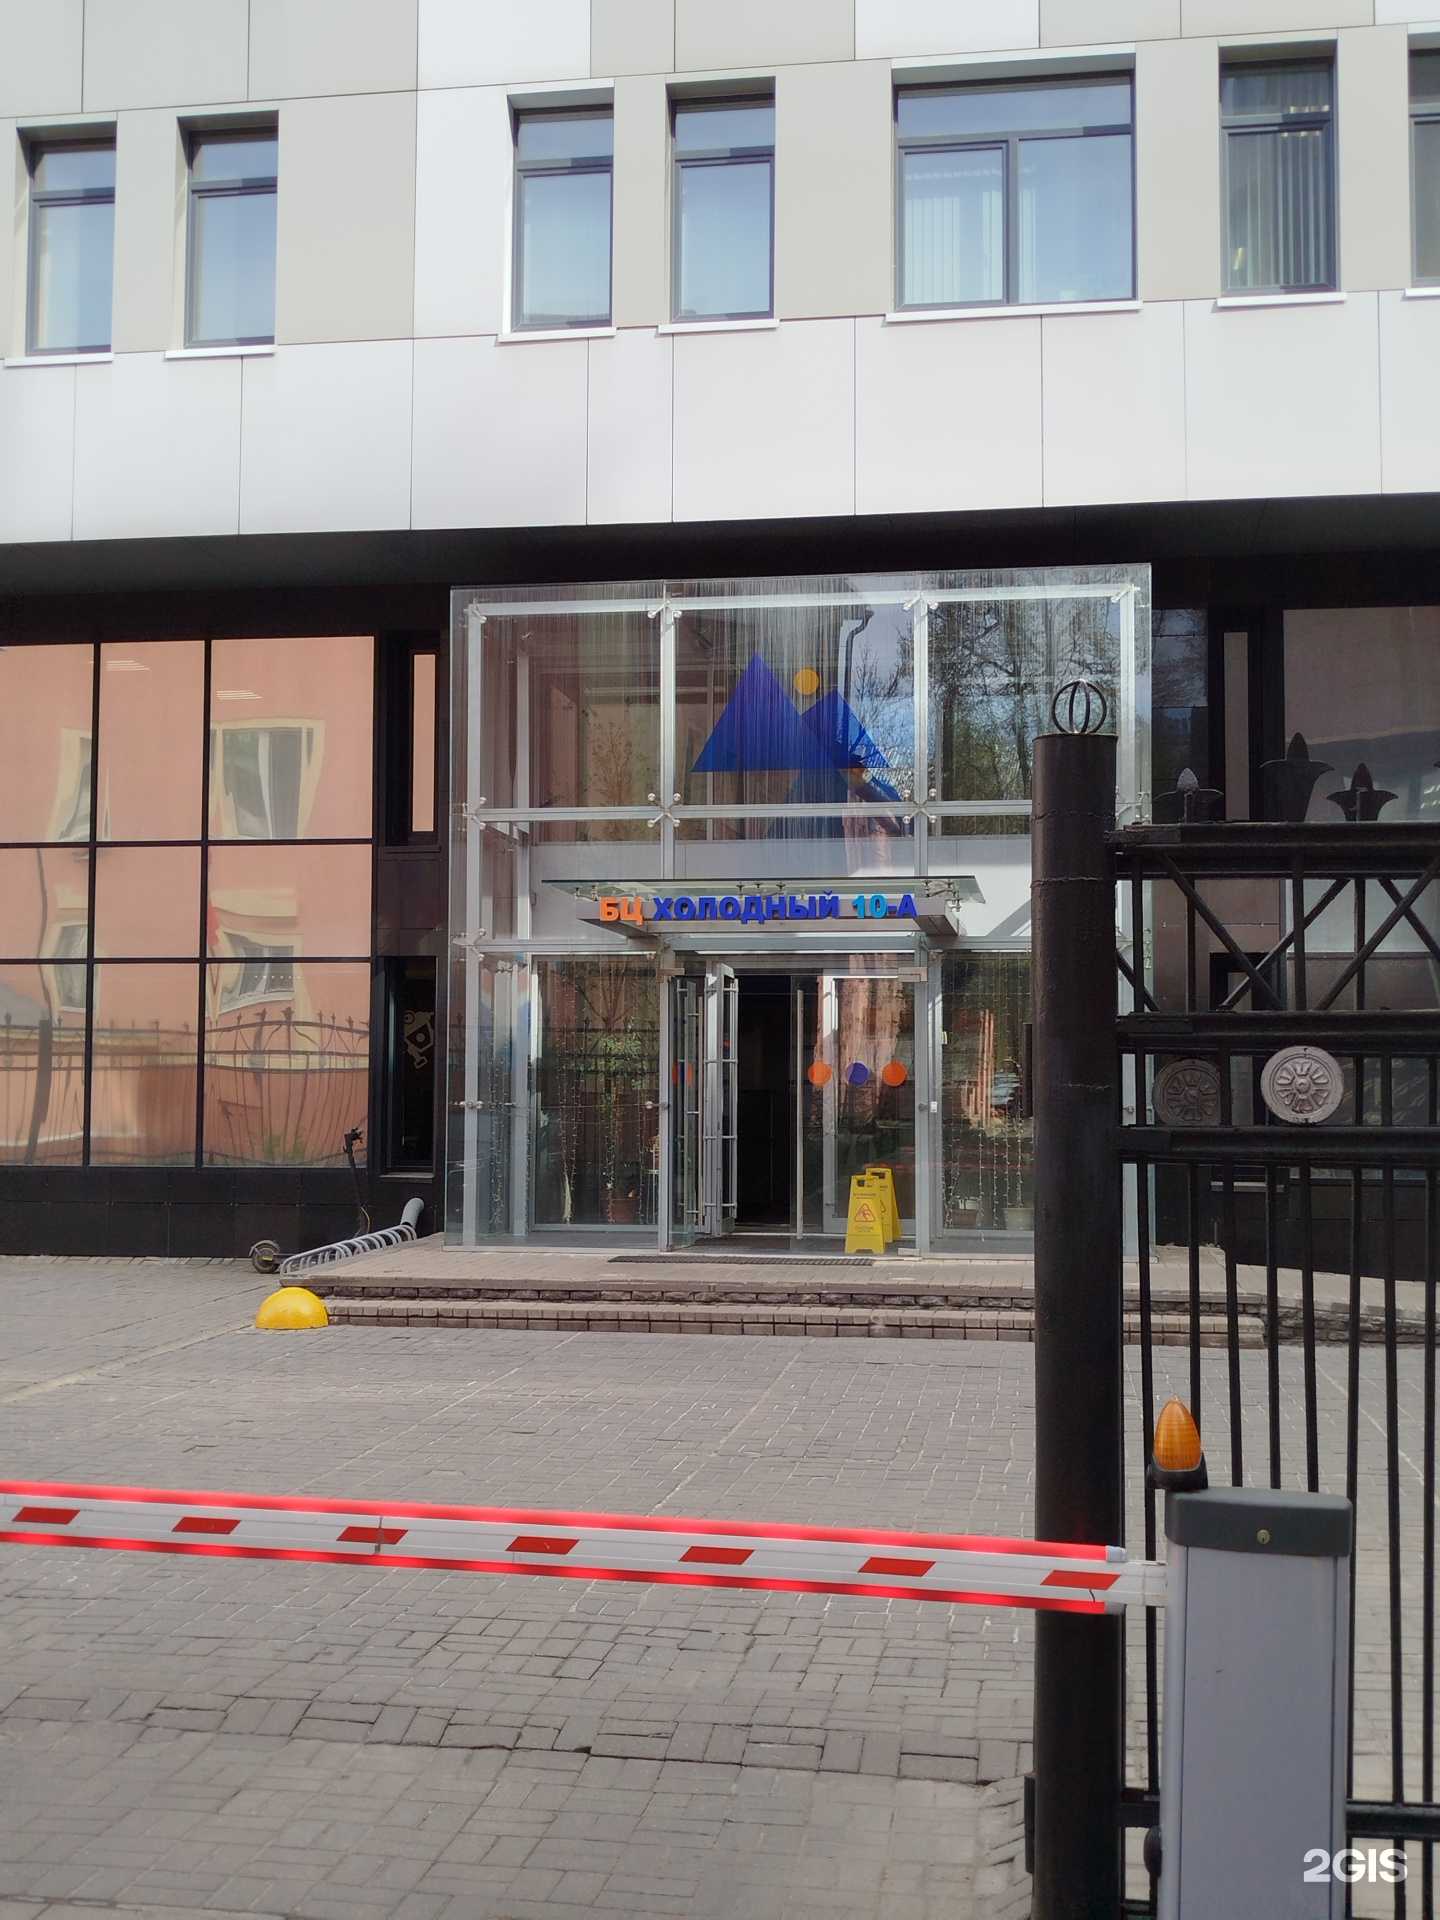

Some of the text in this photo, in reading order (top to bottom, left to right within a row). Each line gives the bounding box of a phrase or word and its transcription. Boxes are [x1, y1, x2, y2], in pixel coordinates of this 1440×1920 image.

[600, 889, 917, 926] БЦ ХОЛОДНЫЙ 10-А
